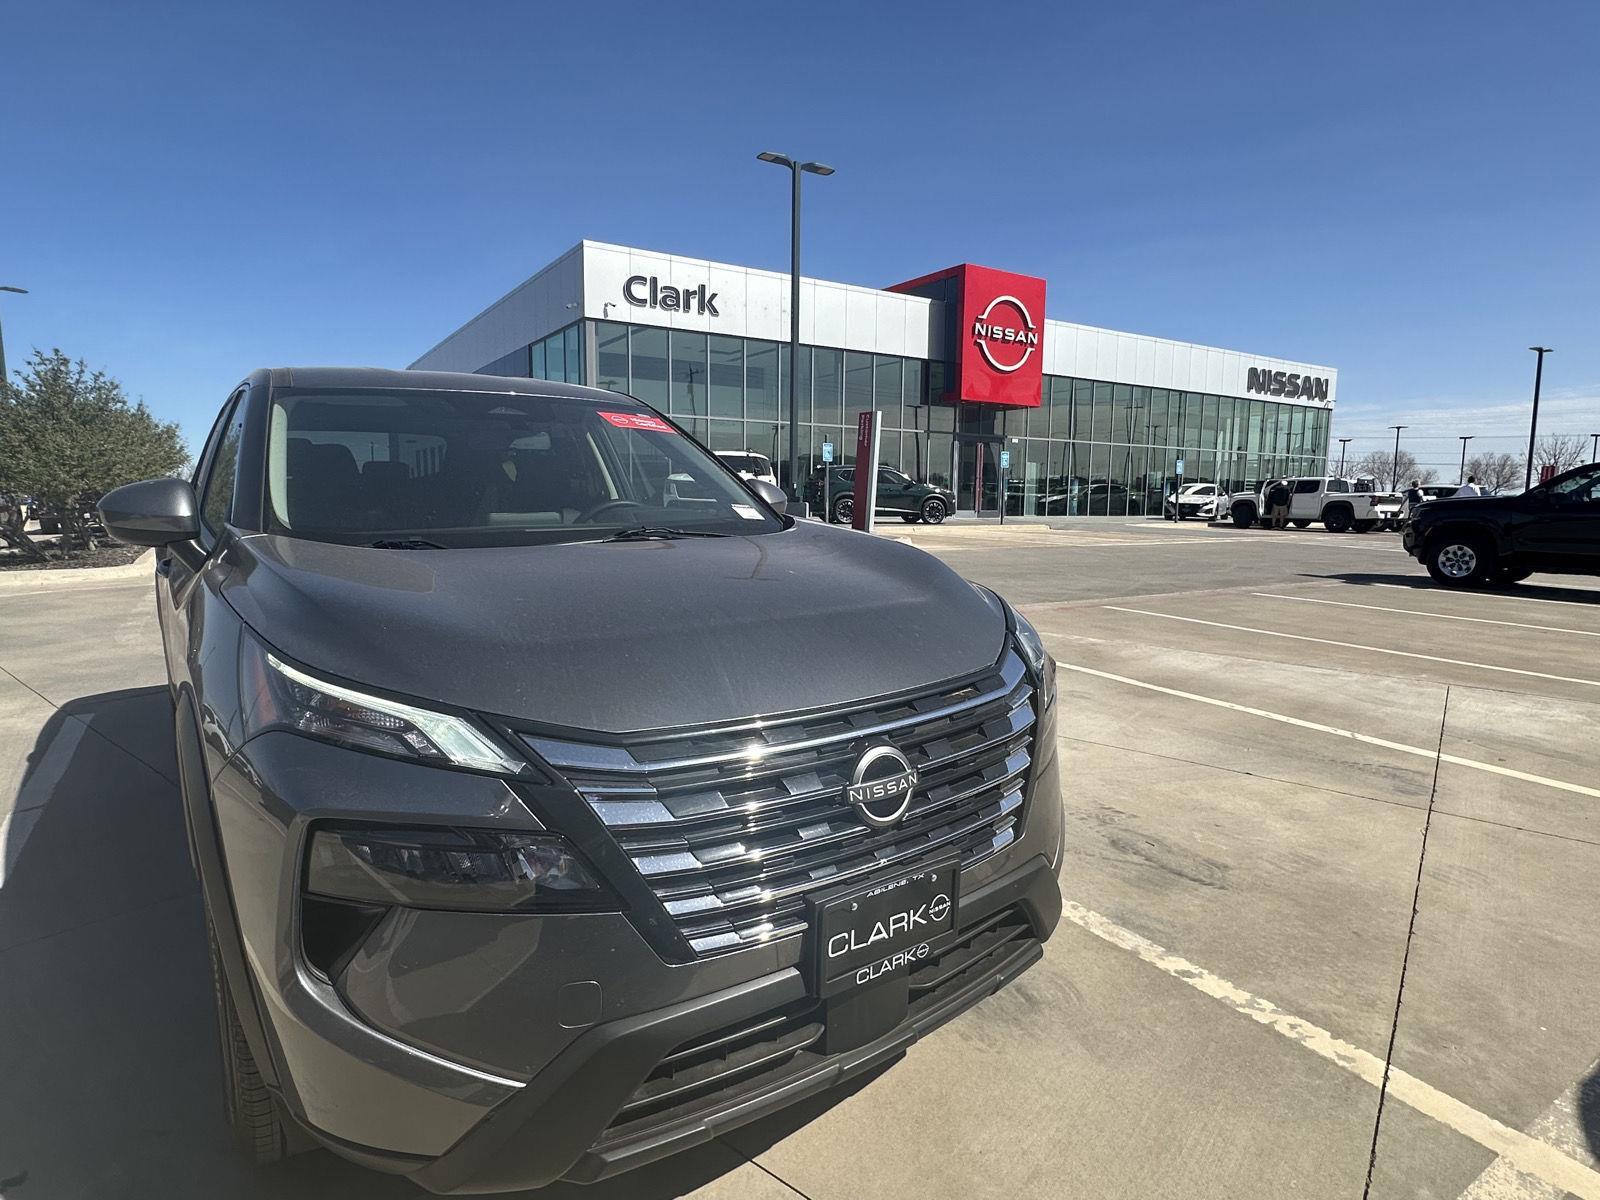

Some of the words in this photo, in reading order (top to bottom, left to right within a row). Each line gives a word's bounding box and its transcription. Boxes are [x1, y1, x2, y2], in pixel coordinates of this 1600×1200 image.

[622, 274, 720, 317] Clark
[975, 322, 1039, 345] NISSAN
[1247, 366, 1329, 402] NISSAN
[849, 771, 918, 803] NISSAN
[912, 872, 926, 881] TX
[827, 903, 928, 959] CLARK
[928, 900, 951, 914] NISSAN
[856, 947, 917, 985] CLARK
